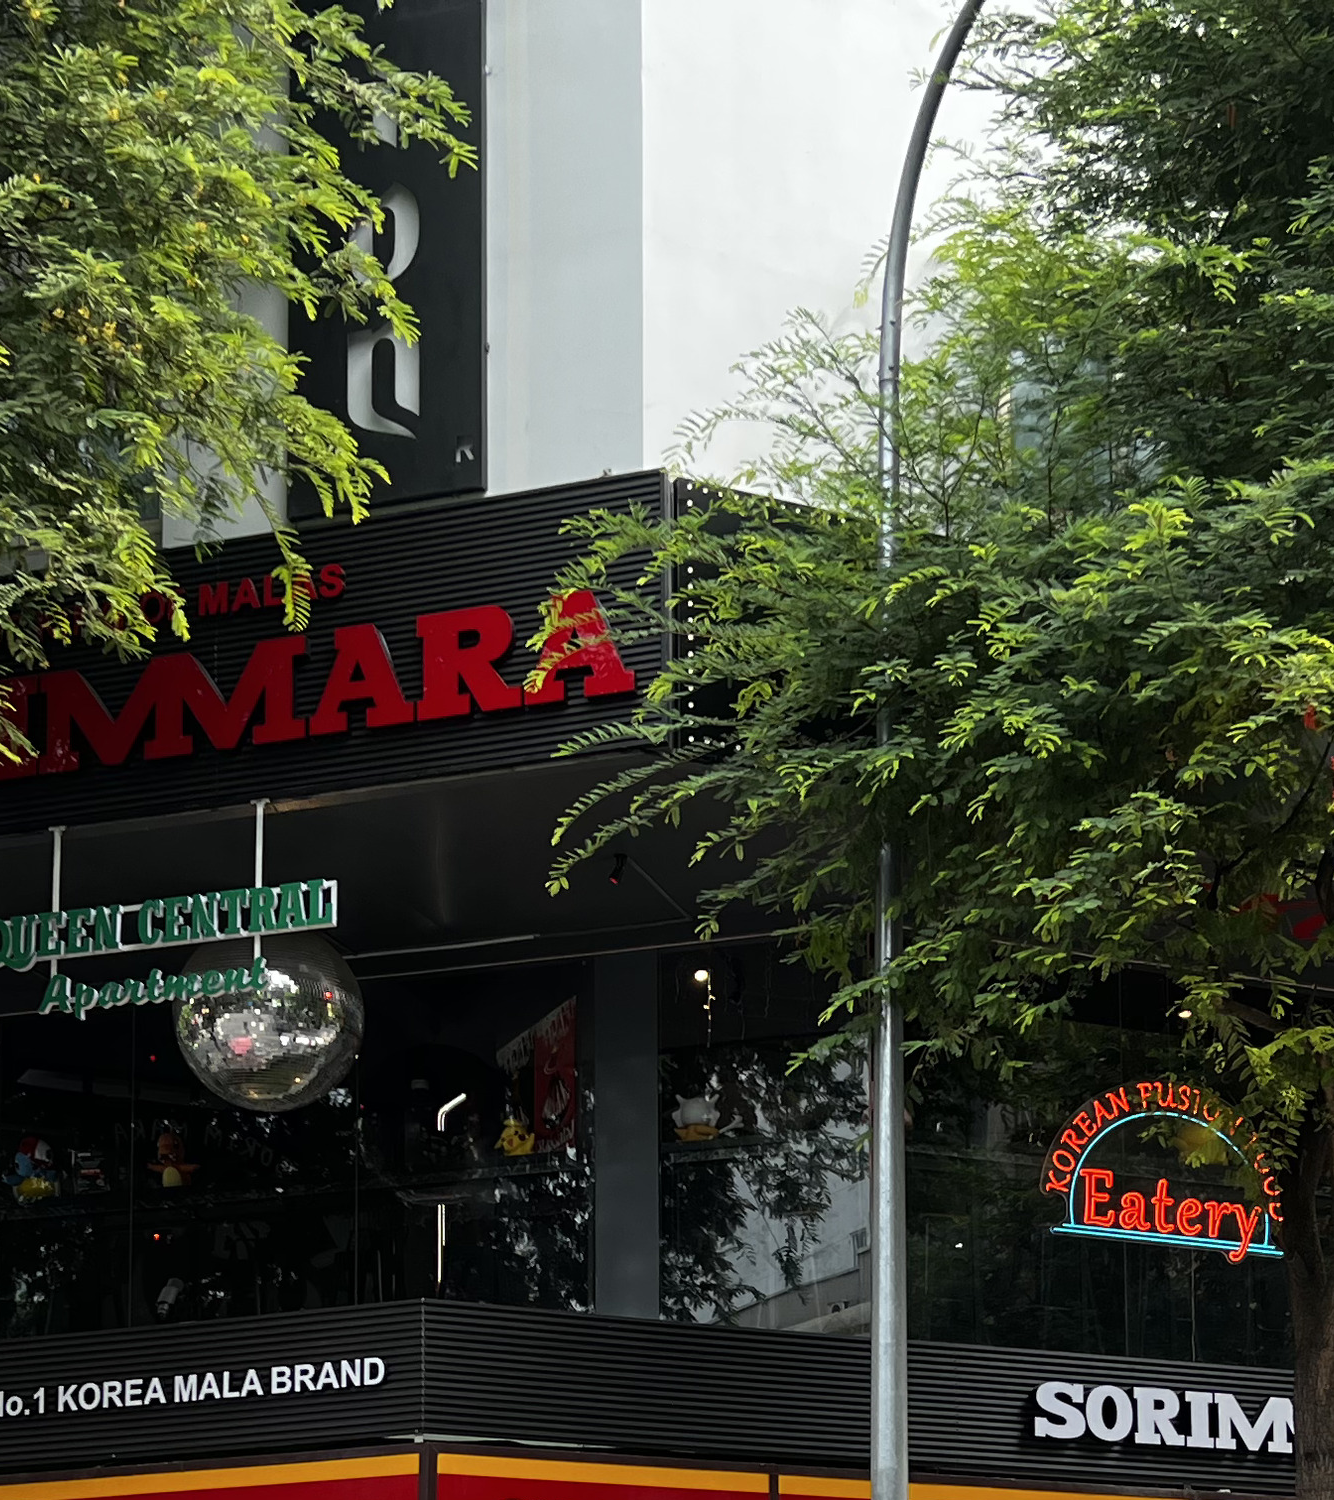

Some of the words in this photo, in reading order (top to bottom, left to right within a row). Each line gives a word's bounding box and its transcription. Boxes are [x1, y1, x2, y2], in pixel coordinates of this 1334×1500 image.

[198, 563, 347, 617] MALAS
[137, 878, 334, 944] CENTRAL
[40, 956, 270, 1020] Apartment
[1045, 1086, 1130, 1193] KOREAN
[1137, 1081, 1245, 1136] FUSIO
[1080, 1168, 1262, 1263] Eatery
[57, 1379, 166, 1413] KOREA
[173, 1368, 264, 1404] MALA
[270, 1357, 386, 1395] BRAND
